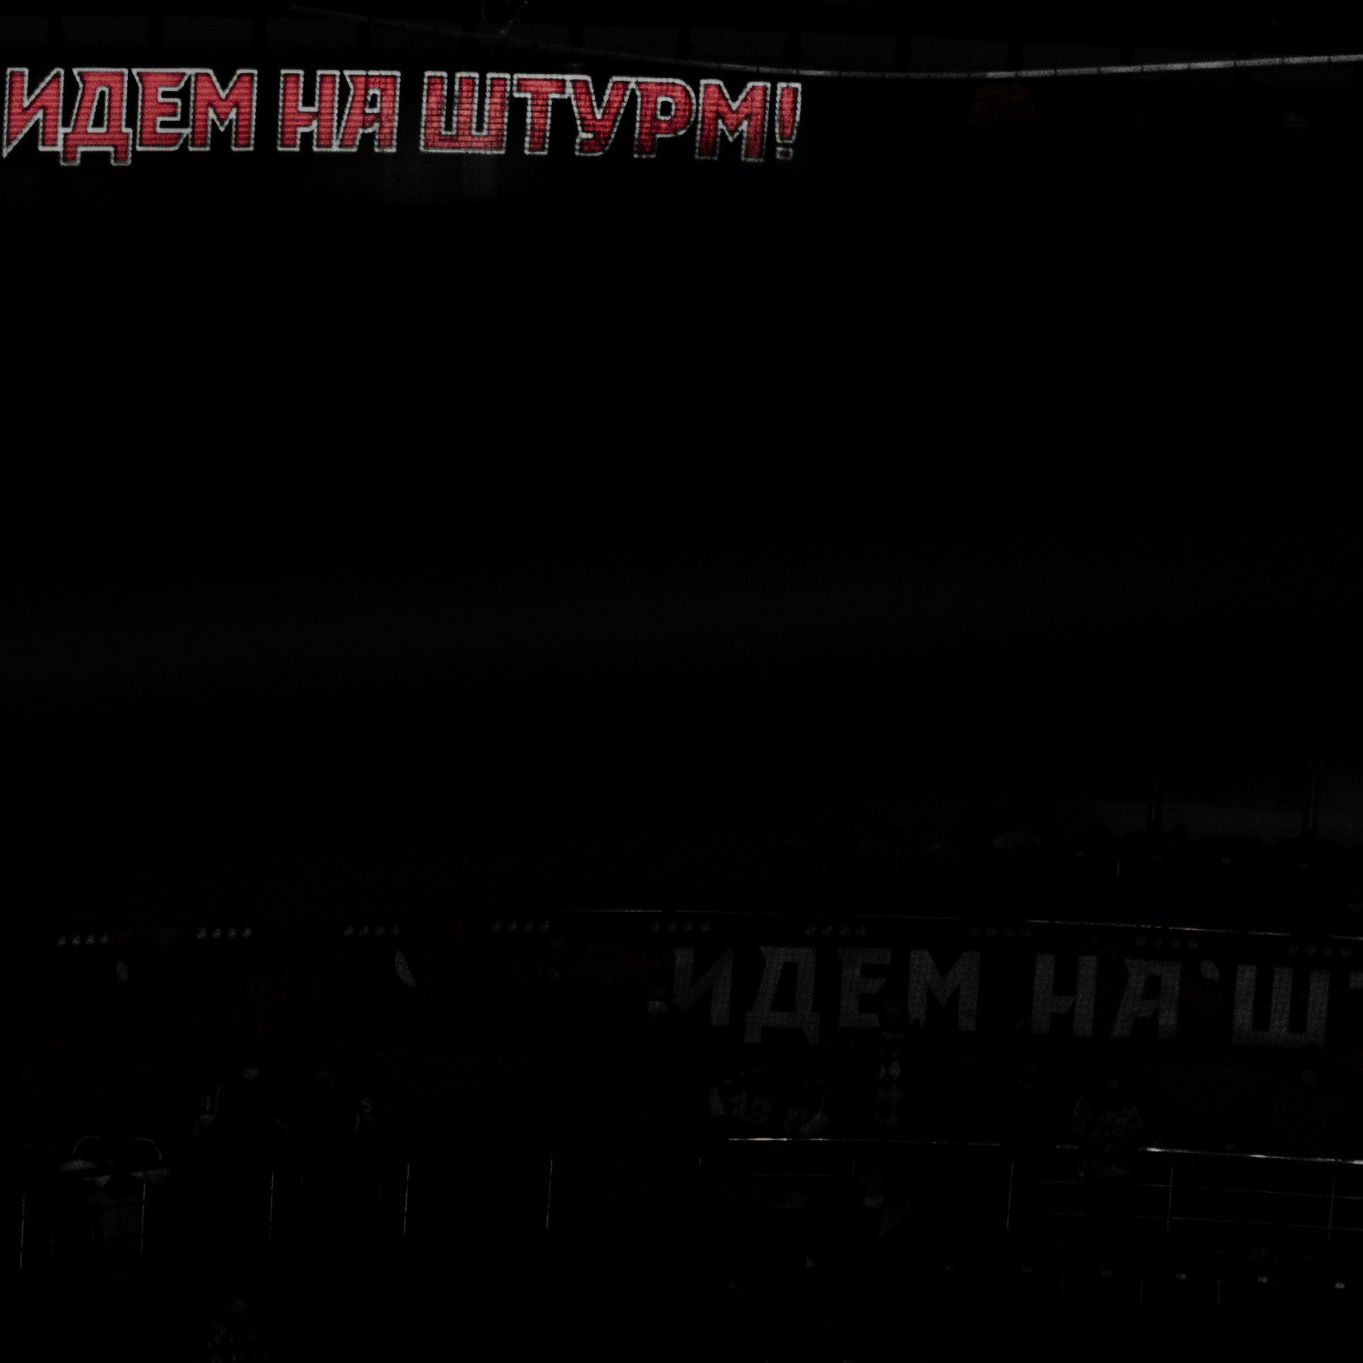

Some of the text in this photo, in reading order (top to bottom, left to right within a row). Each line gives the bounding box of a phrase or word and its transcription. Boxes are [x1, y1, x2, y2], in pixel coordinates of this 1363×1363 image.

[1, 66, 803, 166] ИДЕМ НА ШТУРМ!
[670, 944, 1363, 1050] ИДЕМ НА Ш
